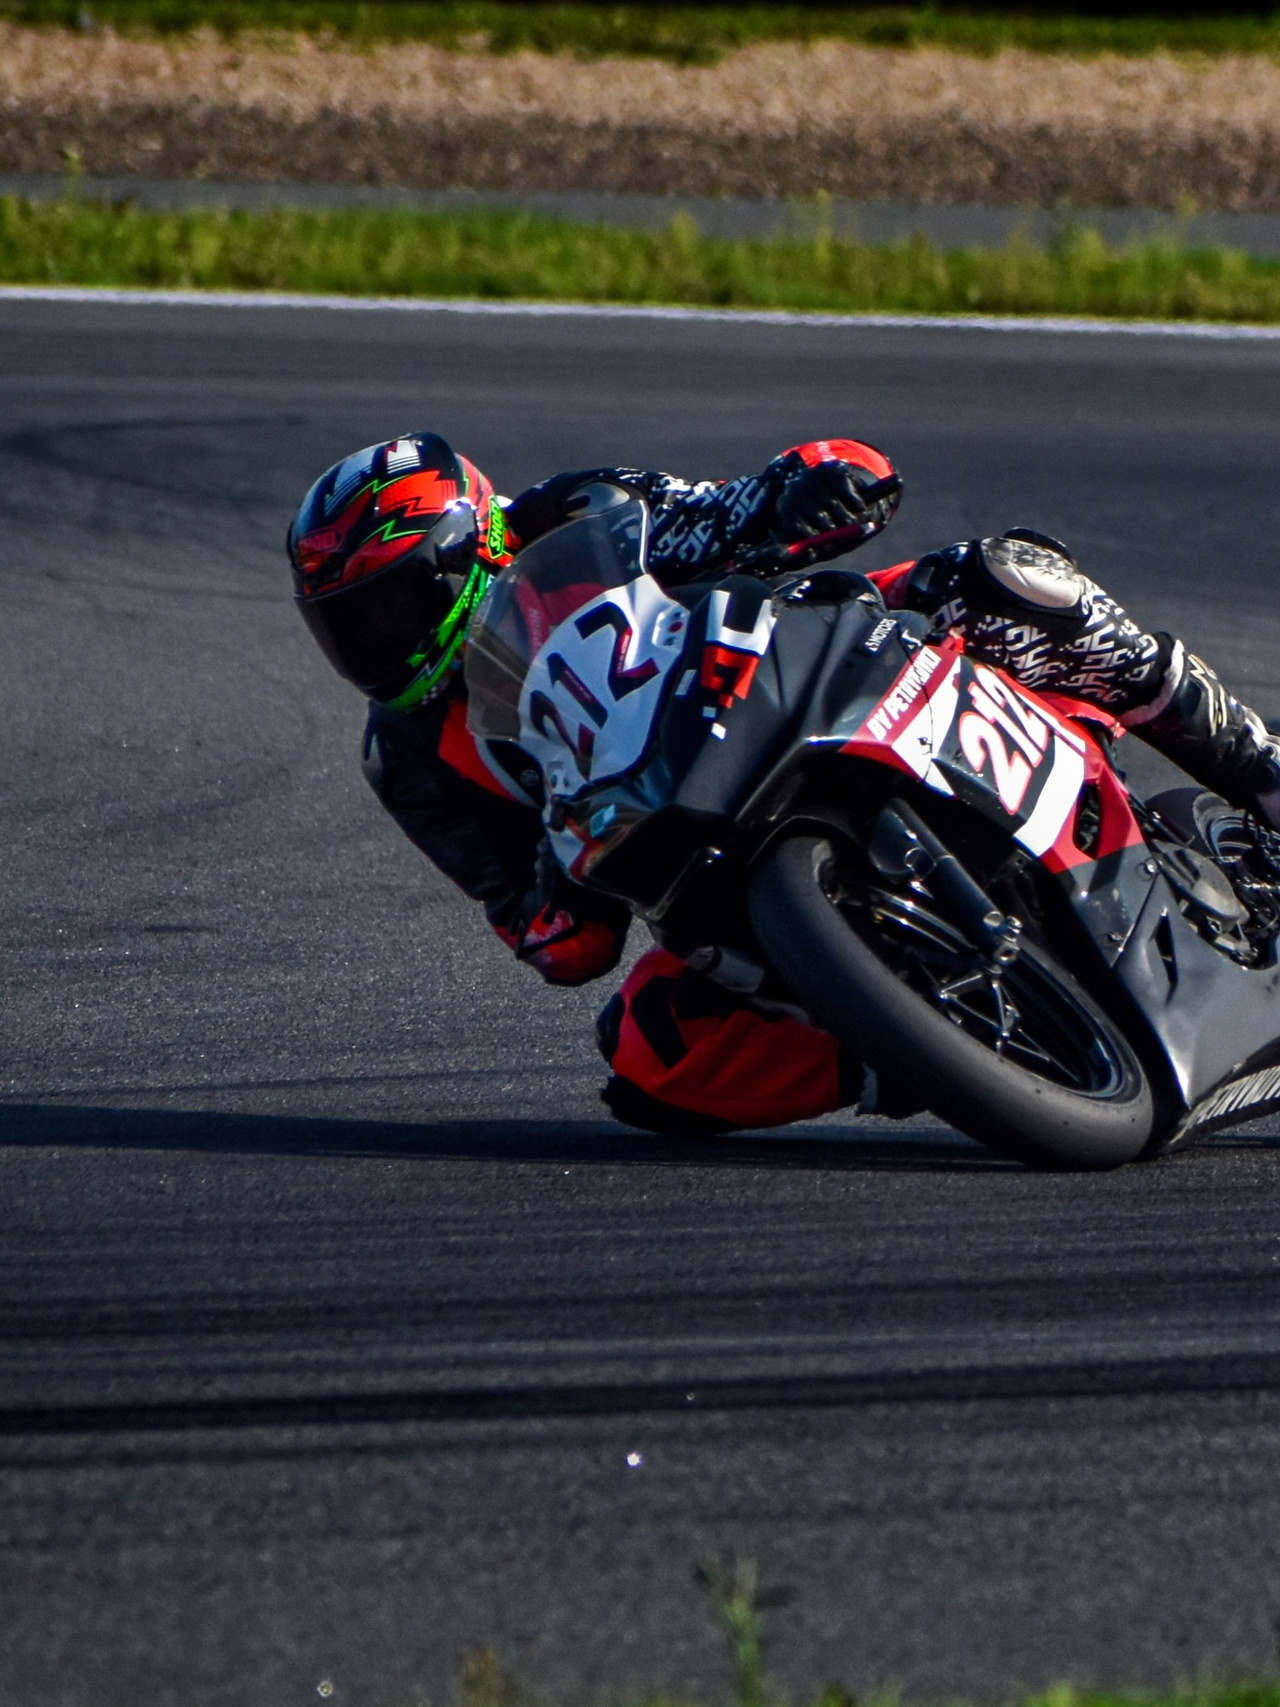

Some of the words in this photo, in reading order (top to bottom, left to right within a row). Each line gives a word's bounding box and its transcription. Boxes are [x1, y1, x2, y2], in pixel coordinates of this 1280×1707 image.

[530, 601, 660, 780] 212
[866, 709, 893, 742] BY
[958, 664, 1050, 815] 212
